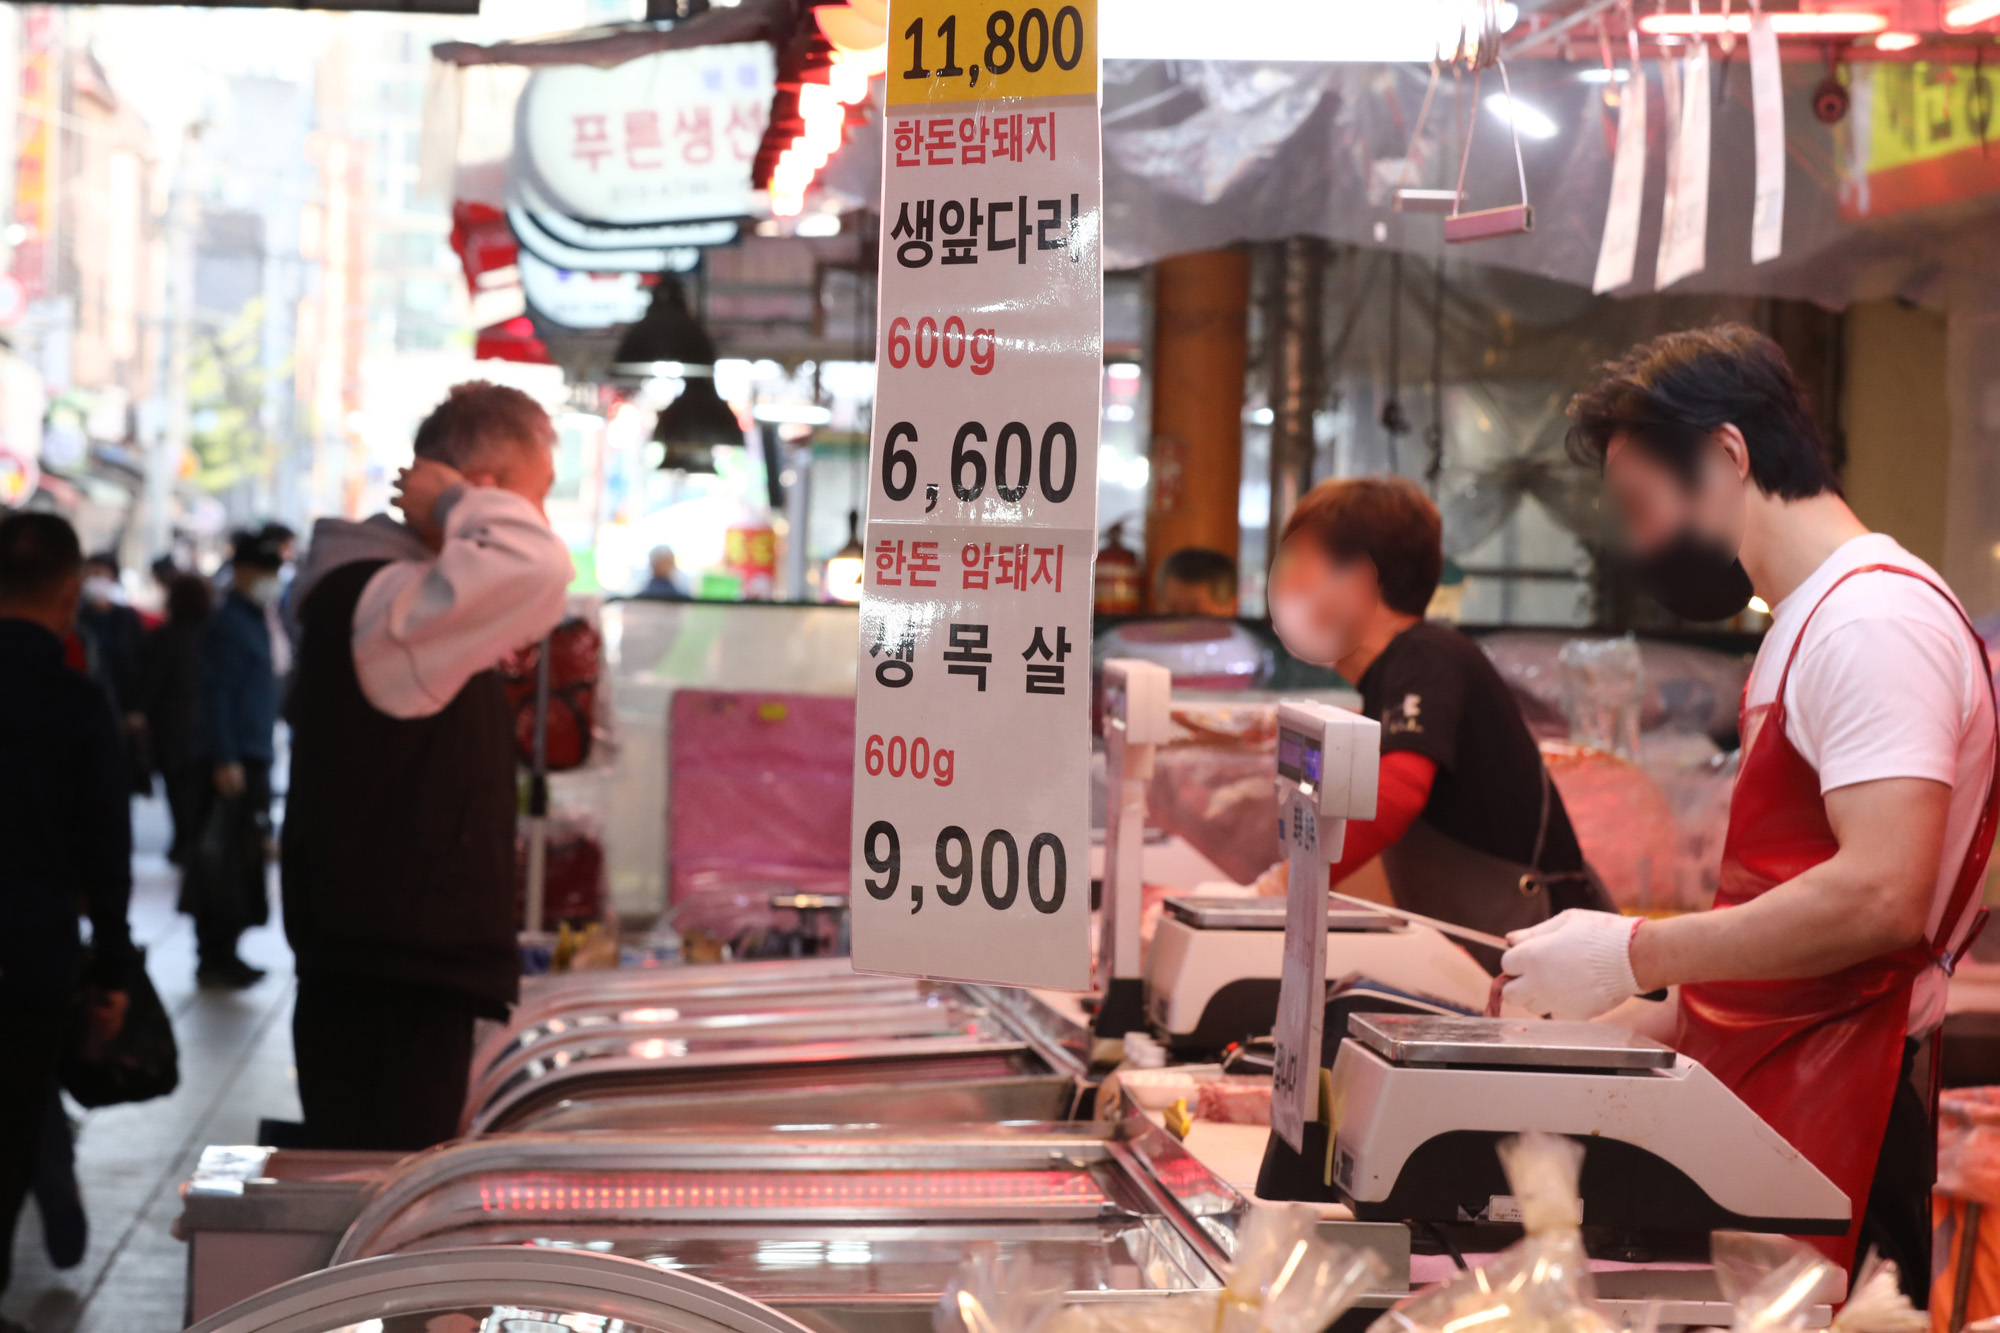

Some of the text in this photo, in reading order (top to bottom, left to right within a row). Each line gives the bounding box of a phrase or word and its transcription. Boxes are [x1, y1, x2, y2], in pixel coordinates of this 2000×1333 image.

[903, 5, 1084, 88] 11,800
[570, 101, 766, 173] 푸른생선
[893, 112, 1056, 167] 한돈암돼지
[890, 193, 1080, 268] 생앞다리
[888, 315, 996, 376] 600g
[882, 421, 1077, 513] 6,600
[875, 539, 1064, 593] 한돈 암돼지
[864, 734, 955, 787] 600g
[863, 820, 1067, 915] 9,900
